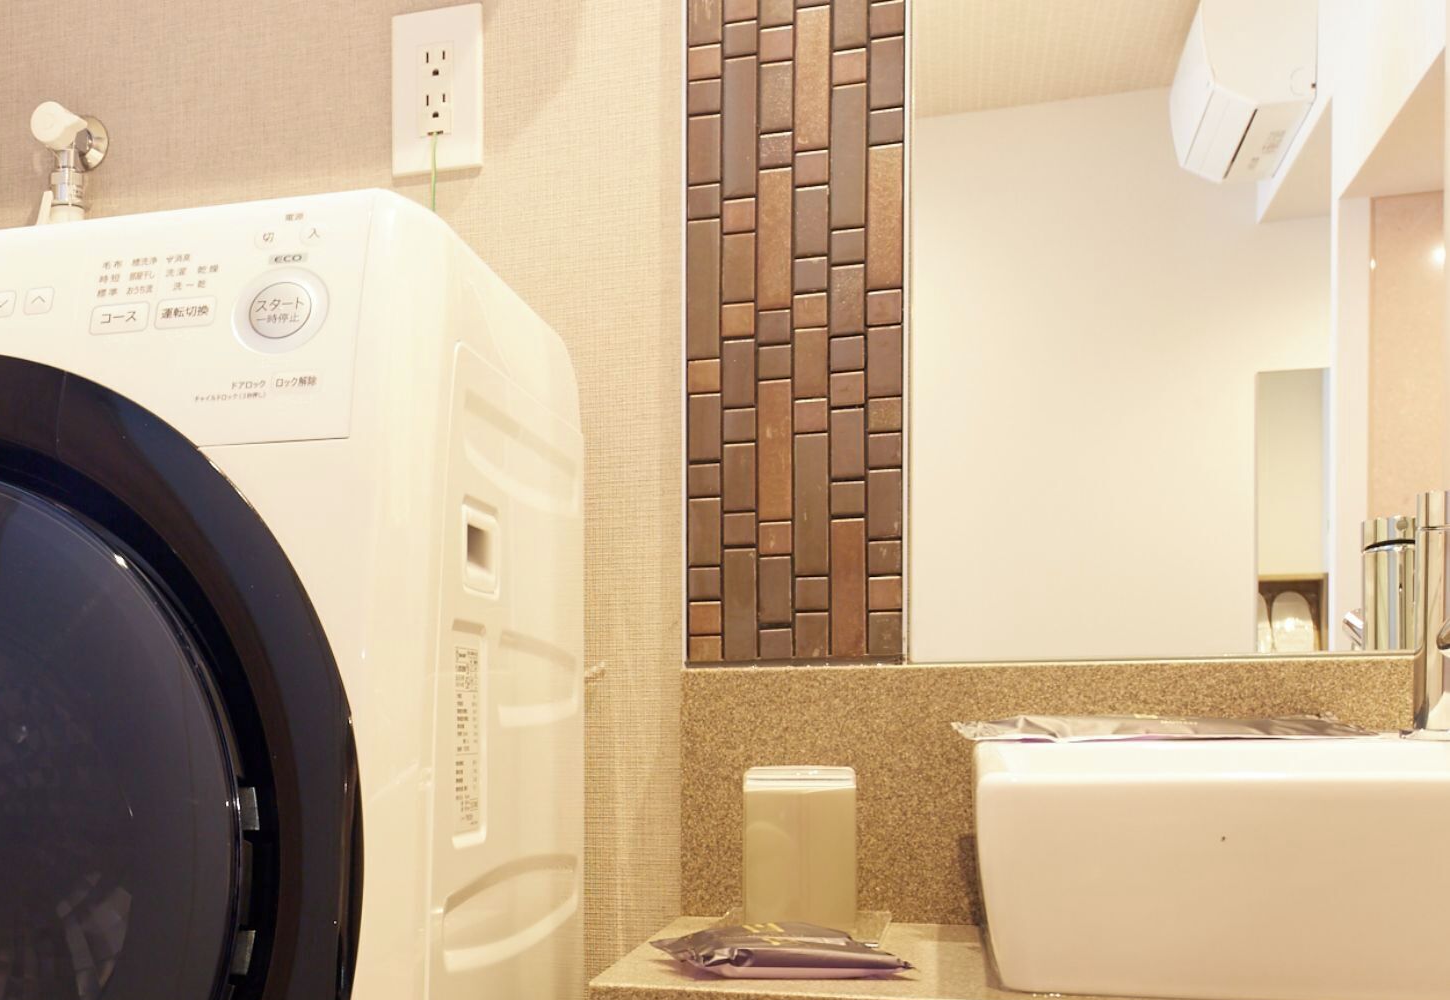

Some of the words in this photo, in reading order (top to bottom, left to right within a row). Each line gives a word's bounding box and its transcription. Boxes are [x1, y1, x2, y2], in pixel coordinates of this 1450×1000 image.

[262, 232, 274, 242] 切
[308, 228, 320, 239] 入
[256, 296, 304, 313] スタート
[100, 311, 136, 324] コース
[160, 305, 209, 319] 運転切換
[256, 313, 300, 324] 一時停止
[231, 380, 266, 390] ドアロック
[275, 376, 317, 388] ロック解除
